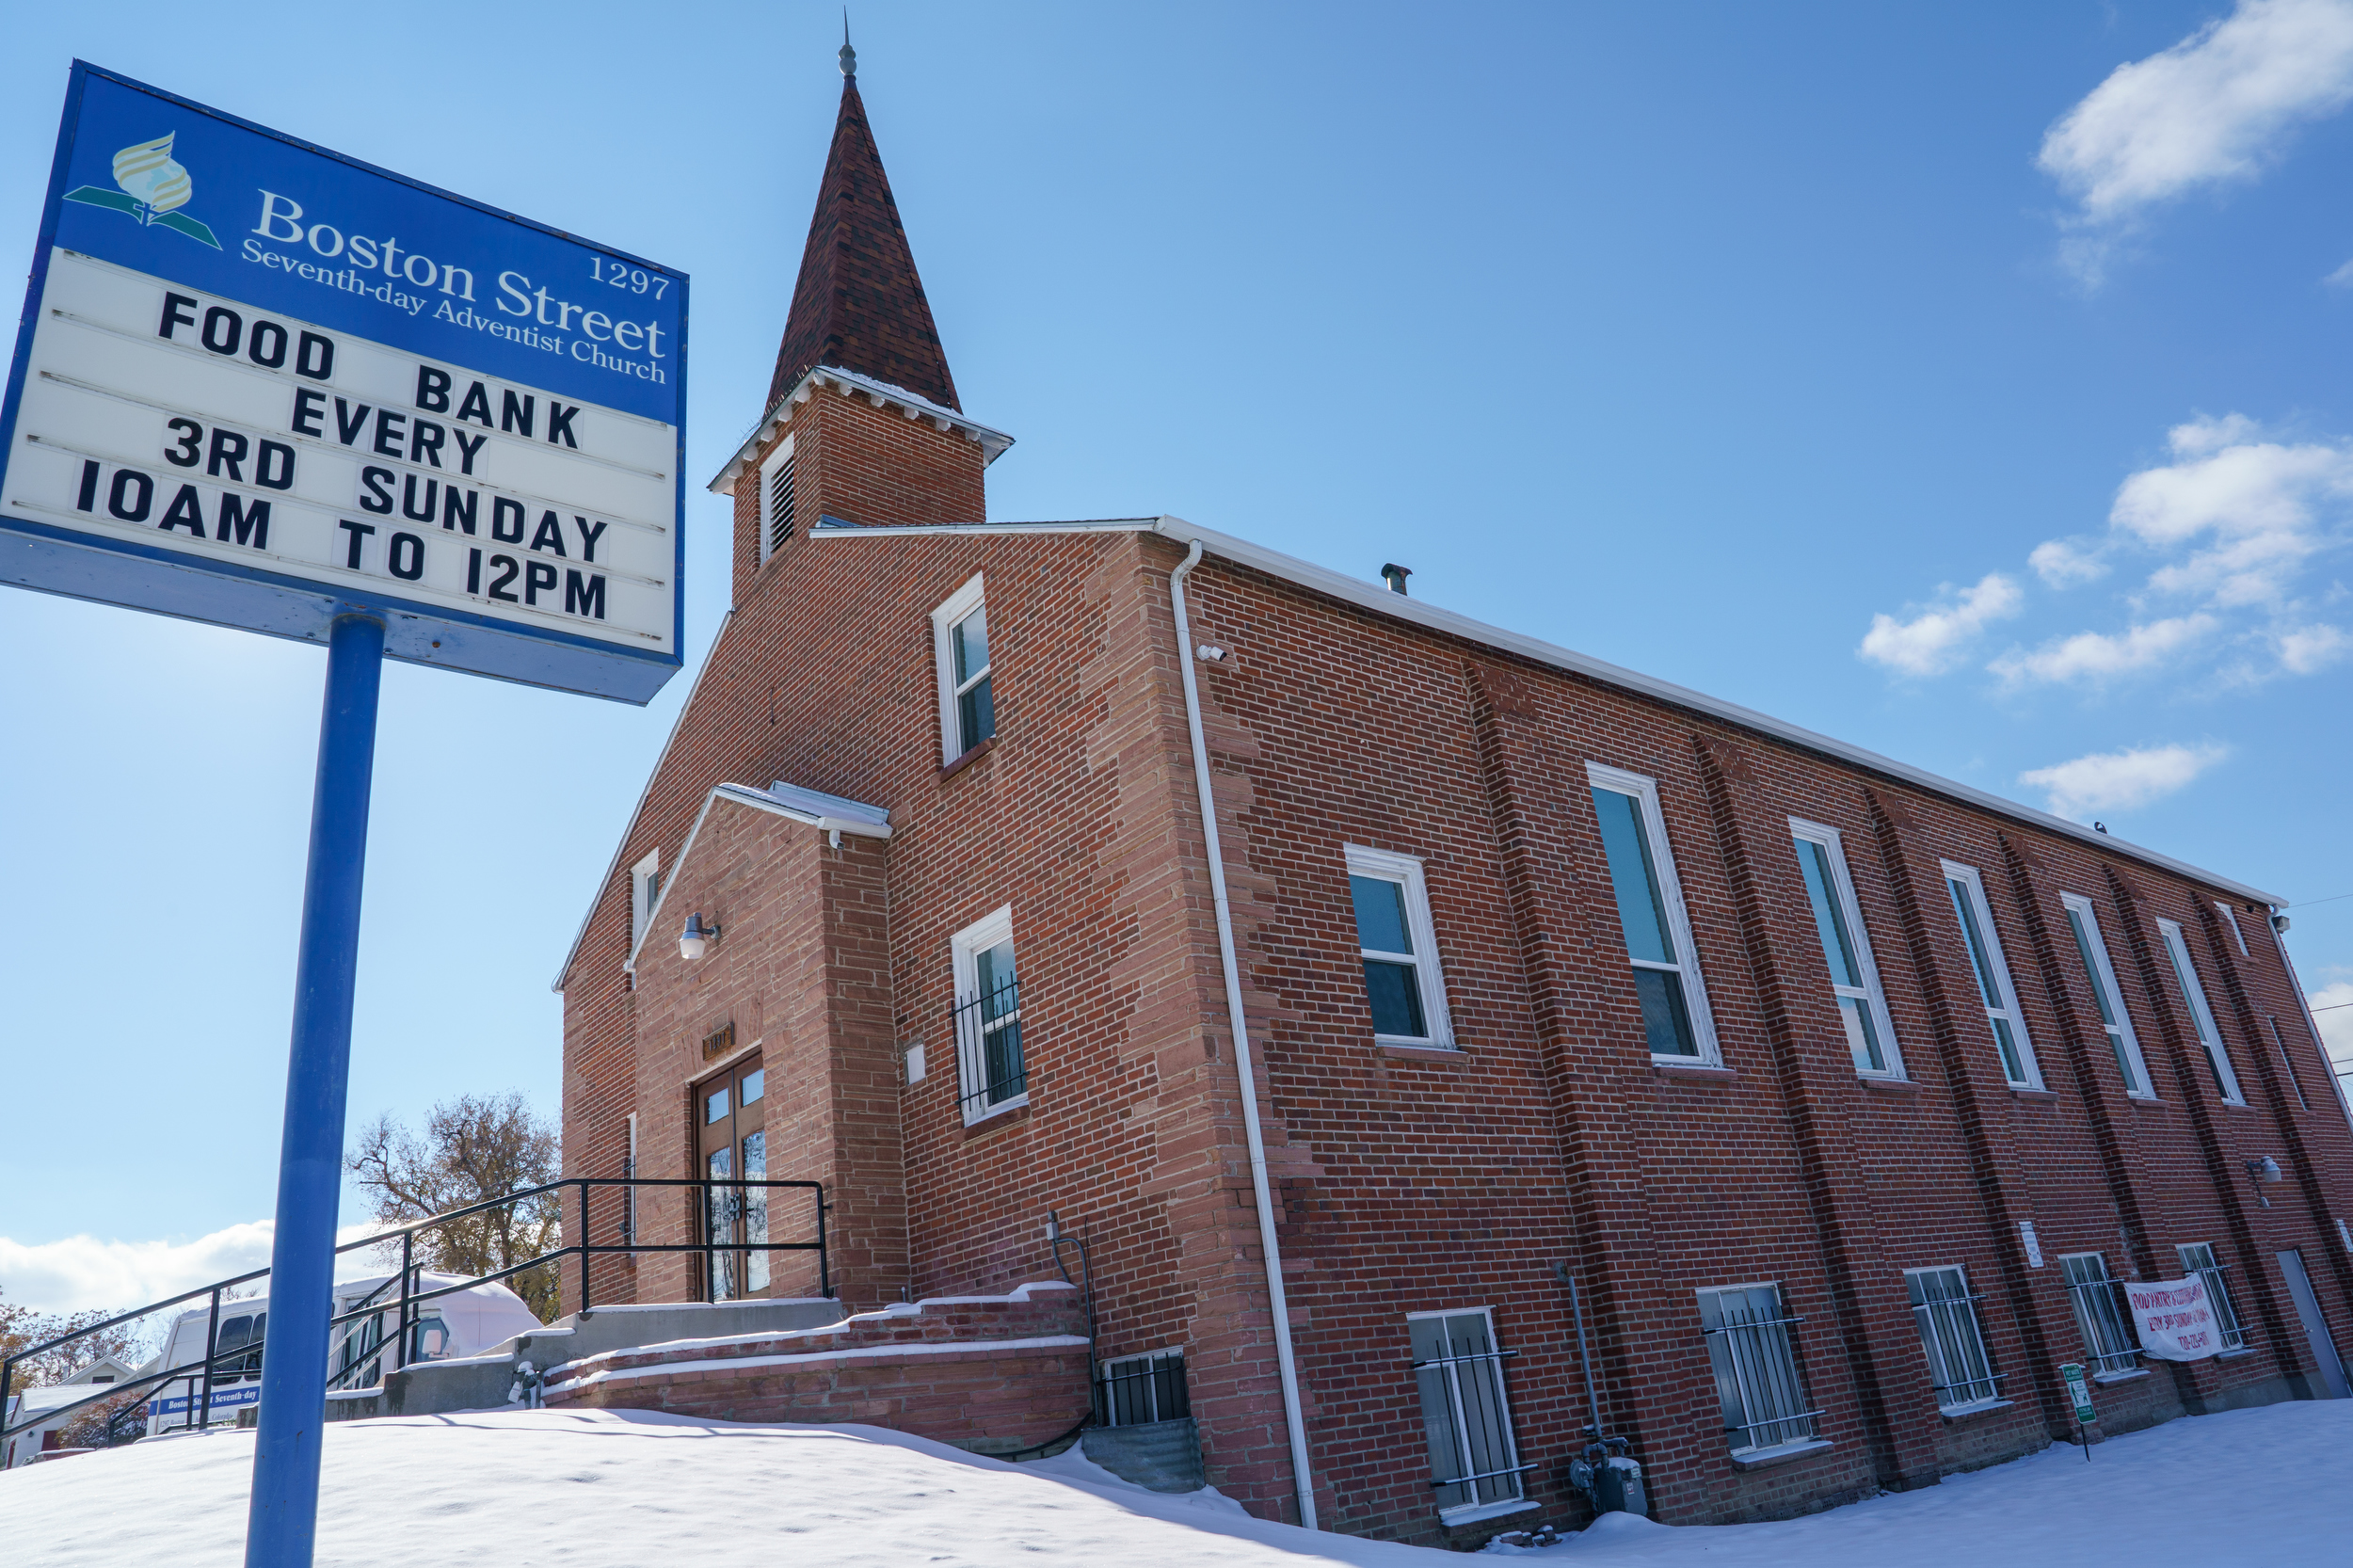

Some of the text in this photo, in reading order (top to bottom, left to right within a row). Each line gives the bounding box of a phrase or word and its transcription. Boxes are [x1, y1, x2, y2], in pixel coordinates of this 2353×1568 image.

[241, 238, 666, 385] Seventh-day Adventist Church
[251, 188, 666, 359] Boston Street
[589, 257, 670, 300] 1297
[158, 291, 581, 450] FOOD BANK
[291, 386, 488, 476] EVERY
[76, 458, 607, 620] 10AM TO 12PM
[164, 417, 608, 563] 3RD SUNDAY
[168, 1390, 257, 1409] Bosto Strt Seventh-day
